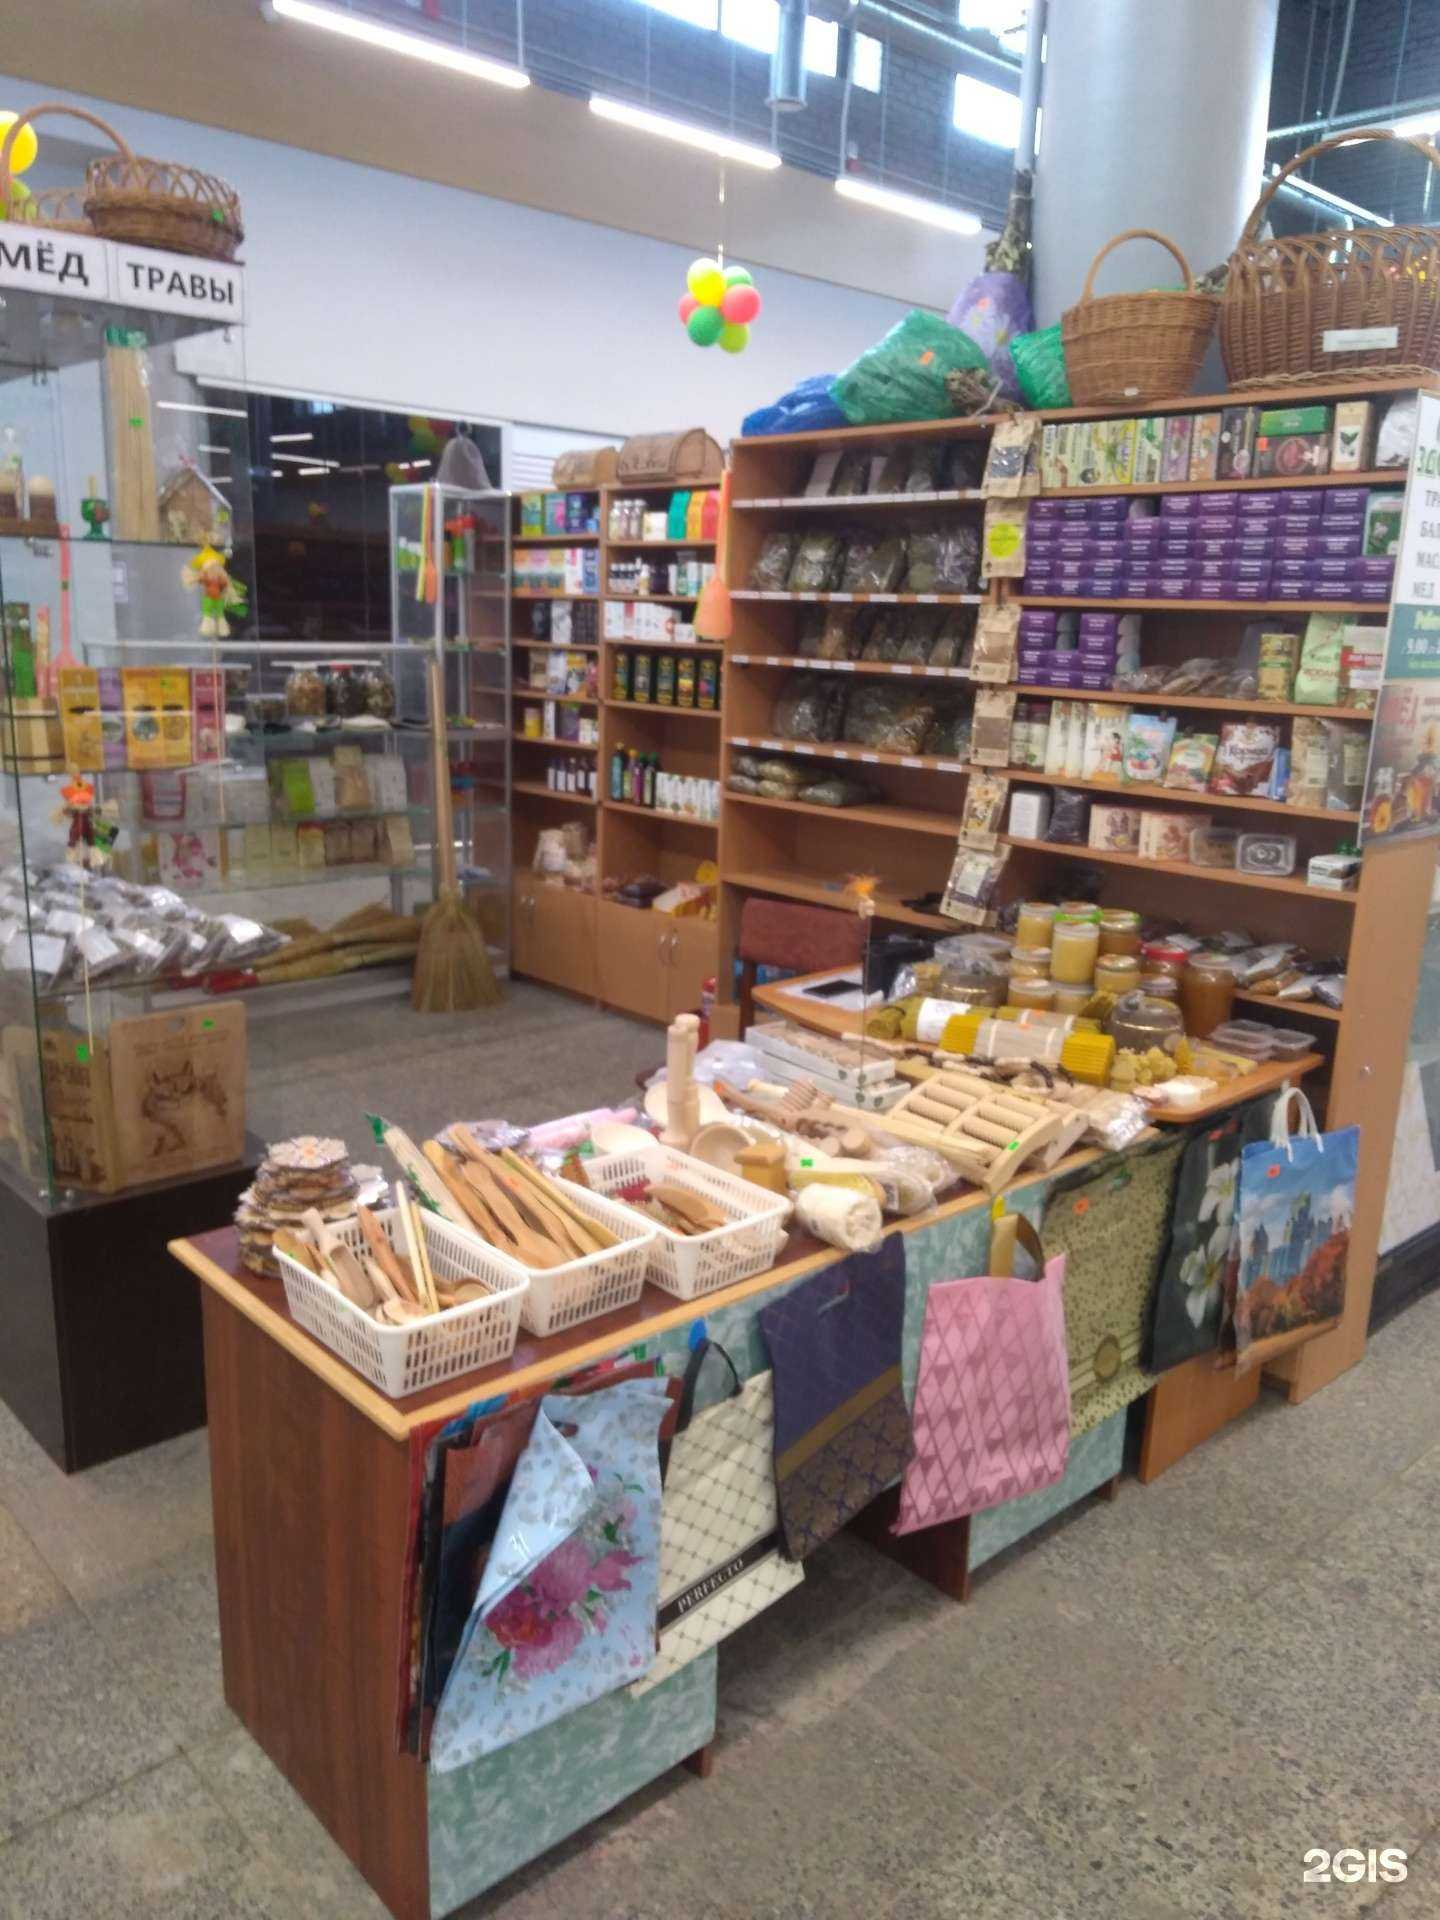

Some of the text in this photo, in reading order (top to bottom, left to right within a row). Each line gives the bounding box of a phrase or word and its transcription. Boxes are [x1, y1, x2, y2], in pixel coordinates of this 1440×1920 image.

[0, 240, 234, 304] МЁД ТРАВЫ
[676, 1557, 745, 1613] PERFECTO
